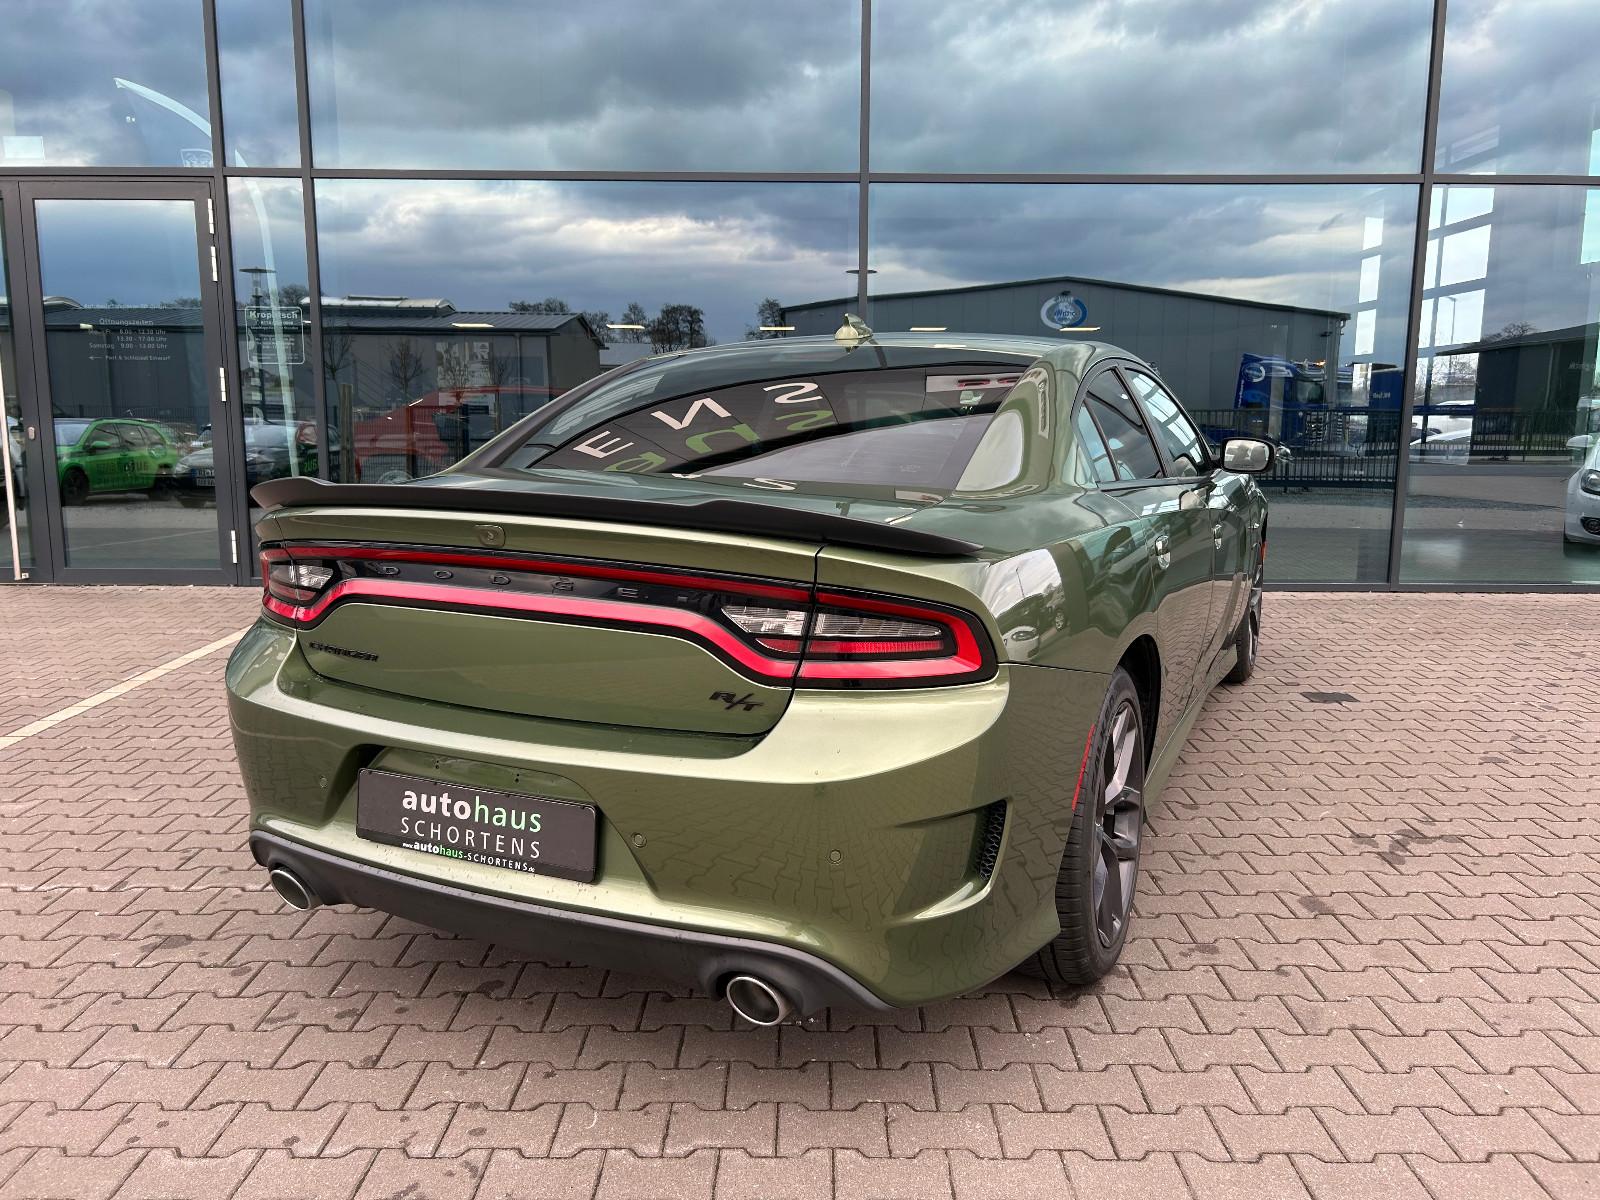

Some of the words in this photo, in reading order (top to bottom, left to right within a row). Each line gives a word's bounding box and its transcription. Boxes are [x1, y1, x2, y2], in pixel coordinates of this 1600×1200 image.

[250, 311, 298, 320] Kropsch
[709, 691, 764, 712] R/T
[402, 790, 542, 833] autohaus
[400, 816, 541, 859] SCHORTENS
